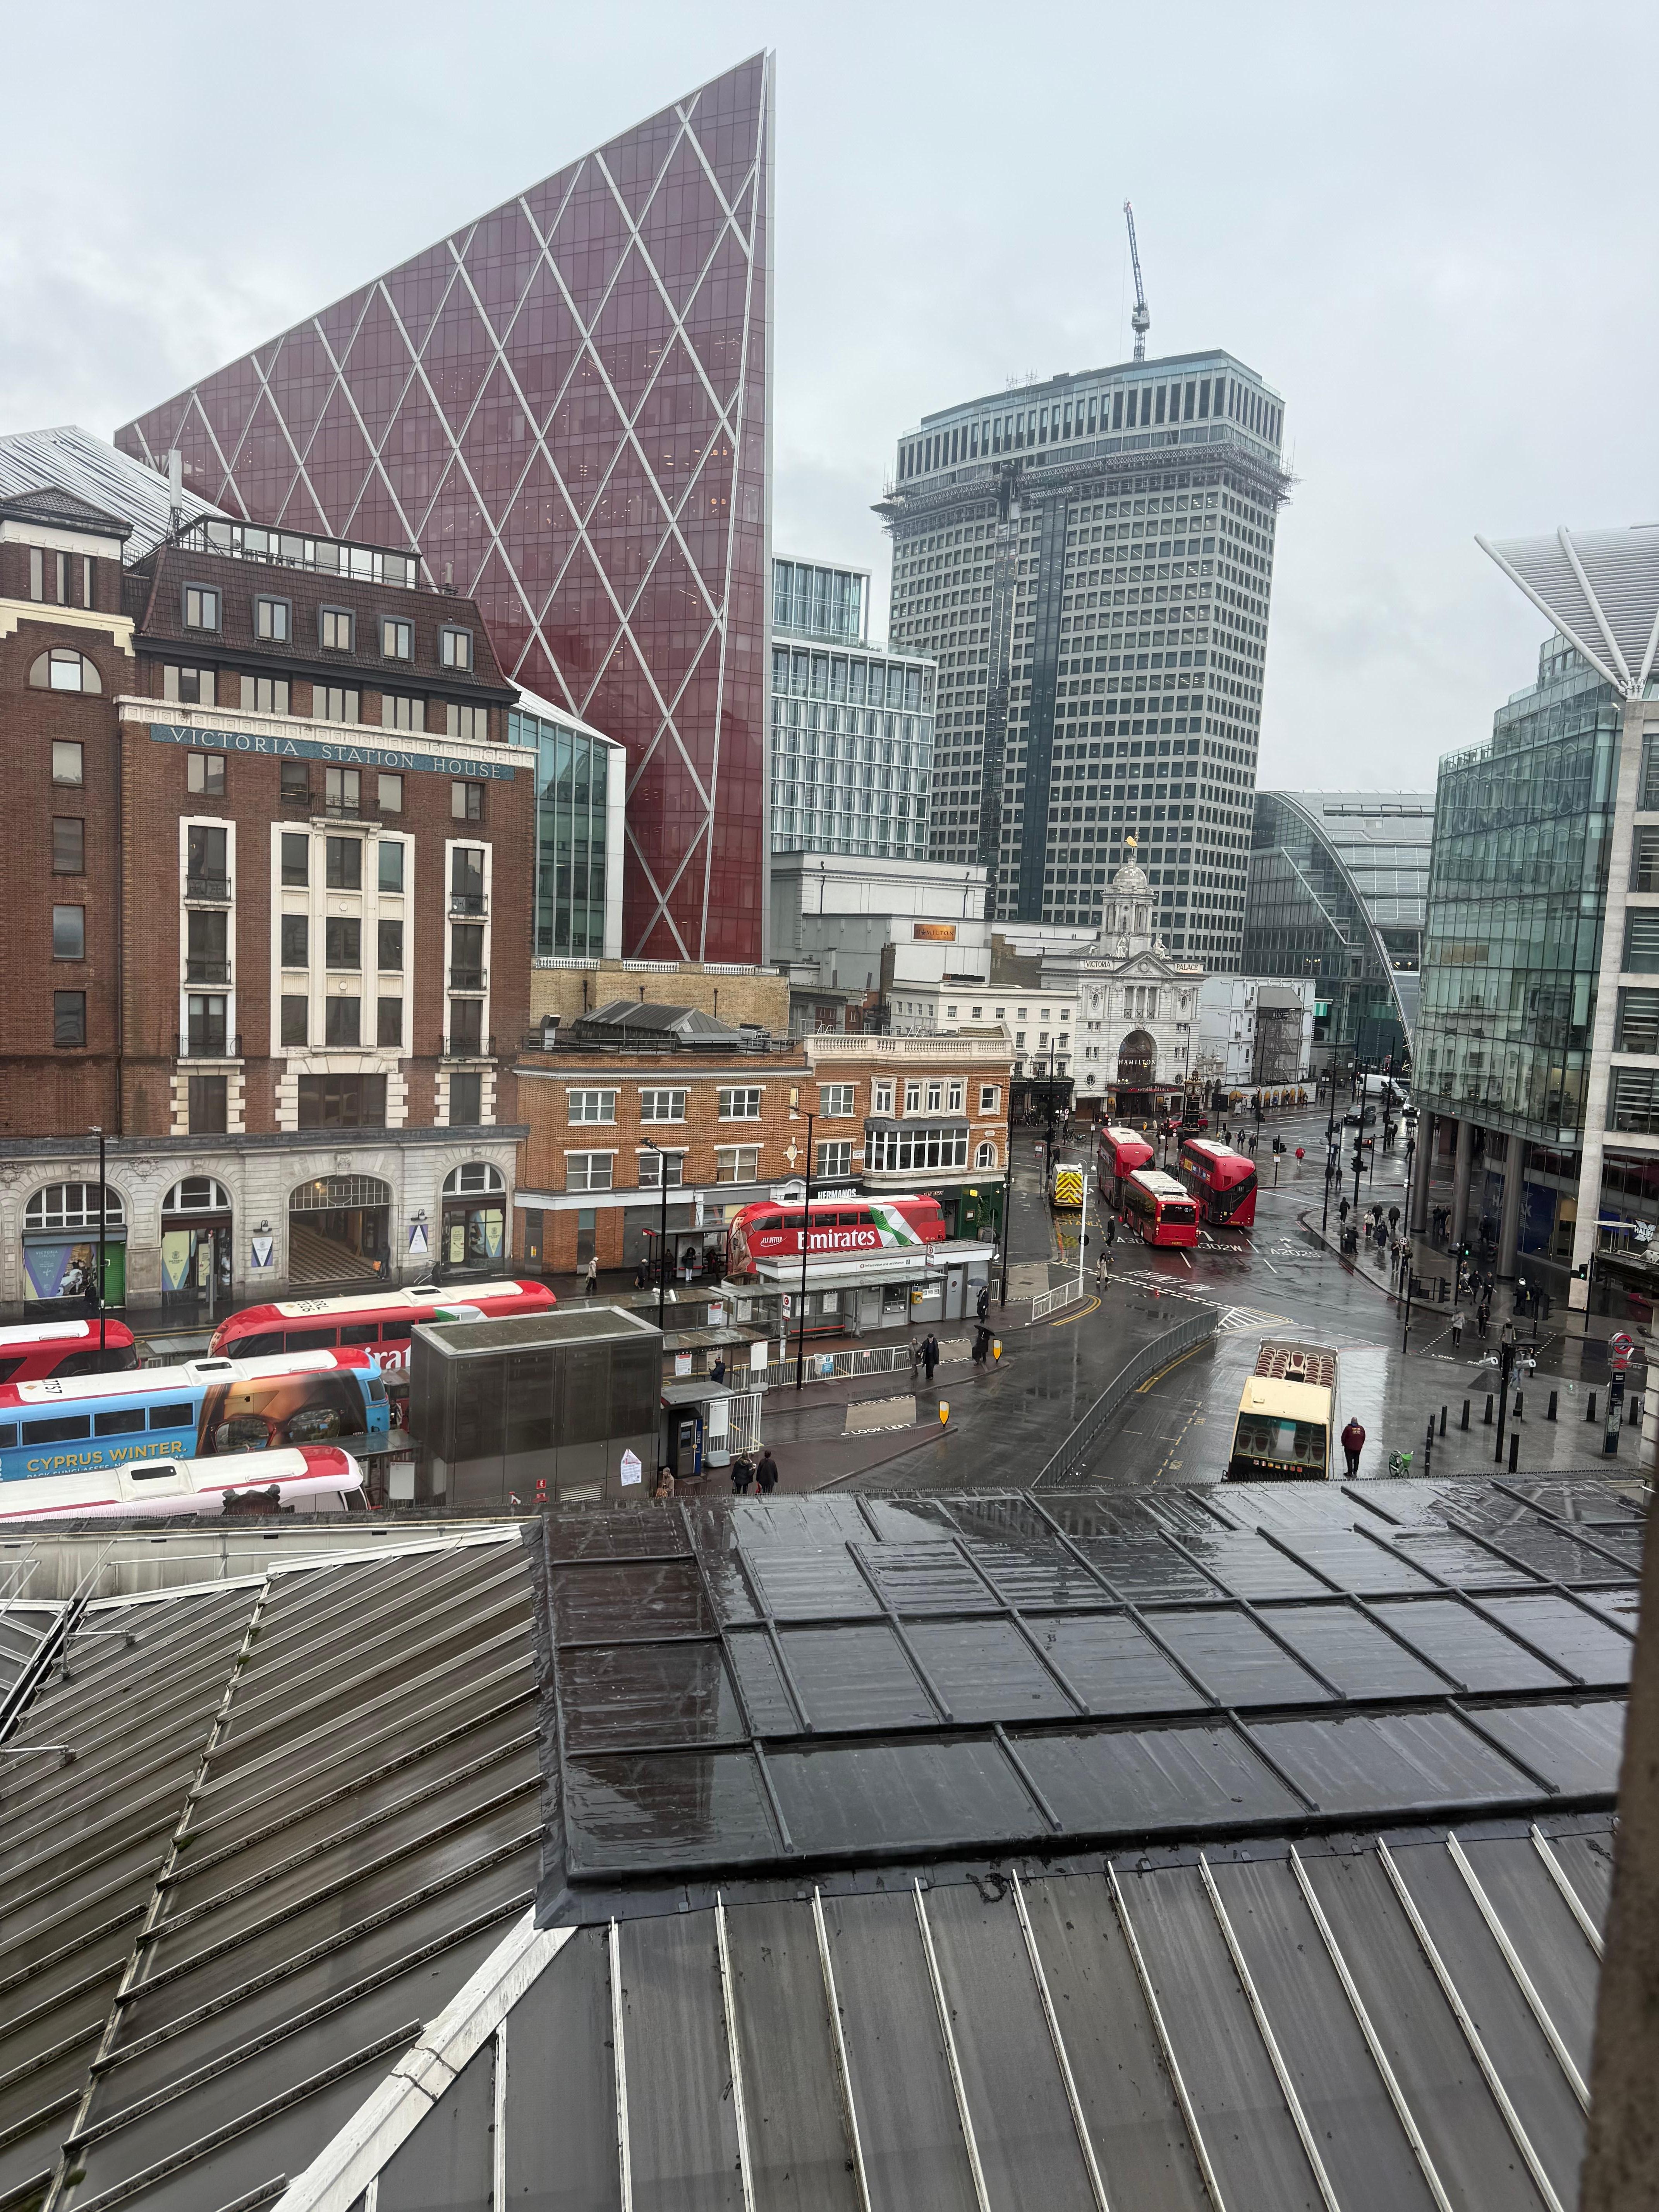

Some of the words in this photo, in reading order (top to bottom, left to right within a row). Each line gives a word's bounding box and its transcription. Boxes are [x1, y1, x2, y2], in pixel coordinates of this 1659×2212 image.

[170, 727, 299, 756] VICTORIA
[321, 745, 413, 768] STATION
[433, 758, 500, 779] HOUSE
[817, 1188, 857, 1199] HERMANOS
[1634, 1226, 1653, 1237] HALIF
[797, 1228, 876, 1250] Emirates
[1123, 1270, 1187, 1284] ENTRY
[1180, 1283, 1216, 1291] NO
[851, 1427, 884, 1435] LOOK
[27, 1451, 103, 1472] CYPRUS
[109, 1441, 187, 1462] WINTER.
